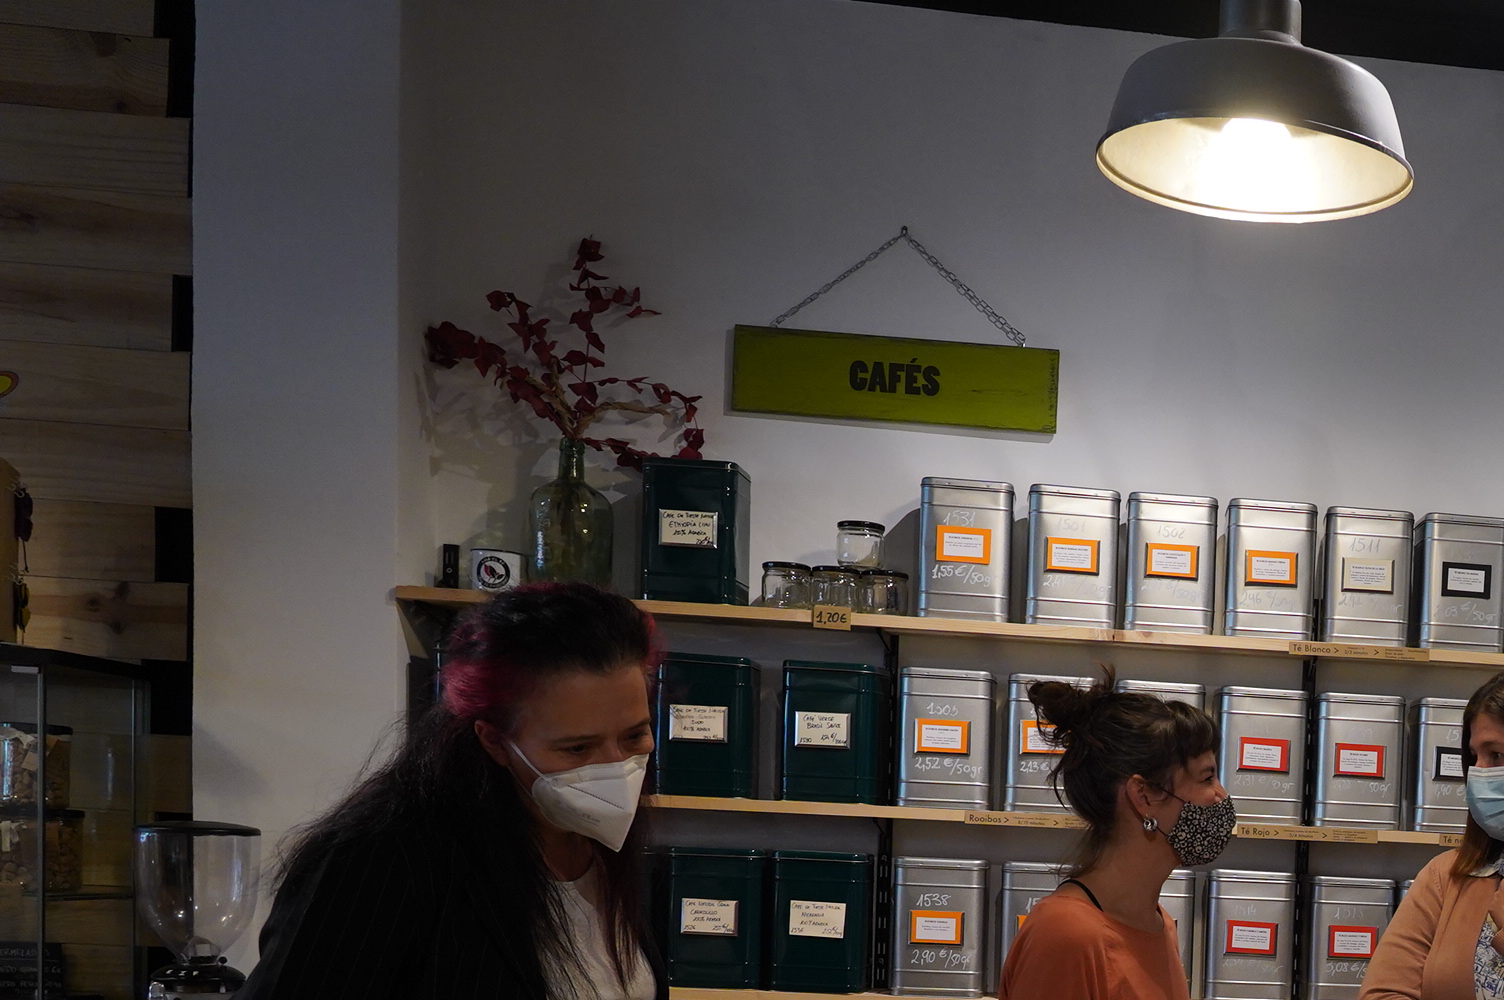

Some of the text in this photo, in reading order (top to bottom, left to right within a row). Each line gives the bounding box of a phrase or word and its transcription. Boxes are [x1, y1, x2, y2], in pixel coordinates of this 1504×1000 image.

[849, 357, 940, 397] CAFÉS
[943, 509, 975, 527] 1531
[815, 611, 847, 626] 1,20€
[1304, 643, 1331, 654] Blanco
[969, 814, 1002, 824] Rooibos
[1241, 827, 1271, 839] Té Rojo
[916, 893, 952, 908] 1538
